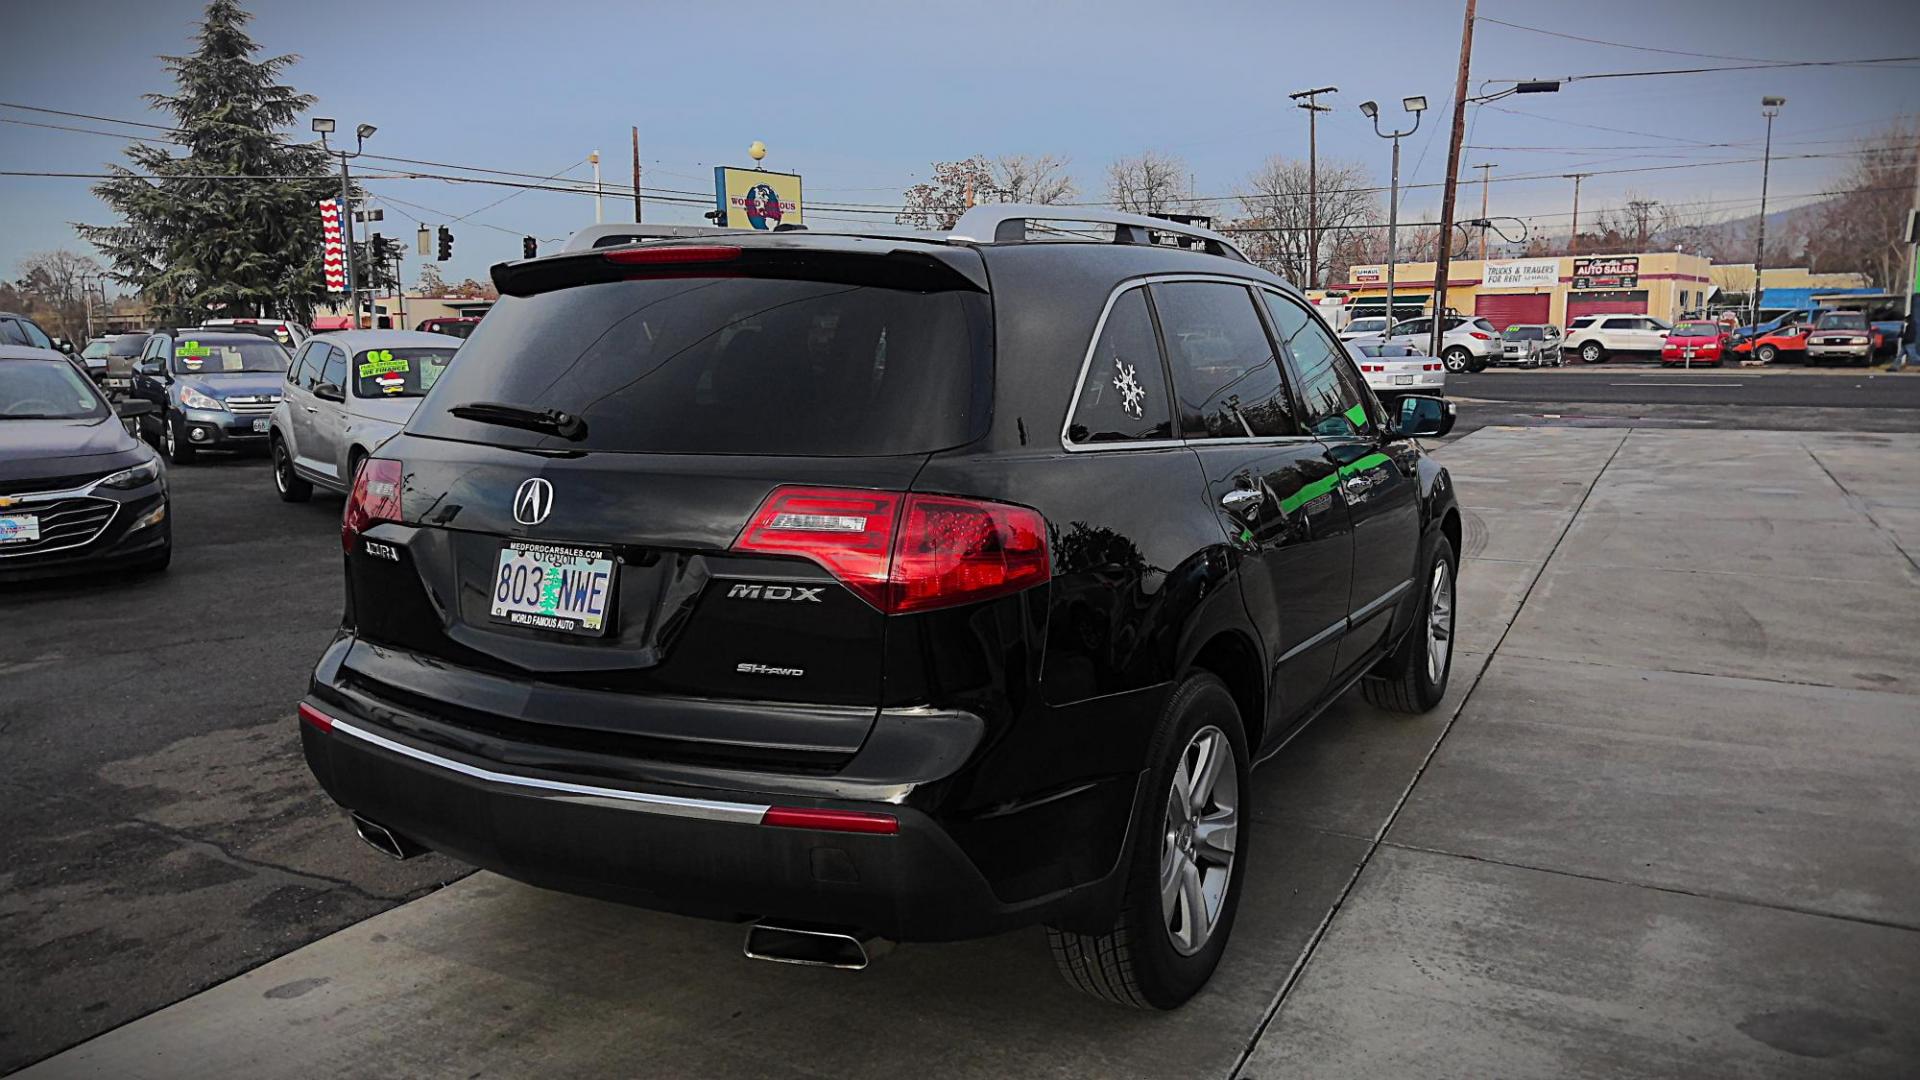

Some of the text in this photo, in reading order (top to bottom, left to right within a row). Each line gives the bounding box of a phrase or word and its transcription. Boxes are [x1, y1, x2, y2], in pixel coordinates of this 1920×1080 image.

[731, 198, 796, 210] WOD FOUS
[1488, 267, 1512, 275] TRUCKS
[1523, 265, 1554, 274] TRAILERS
[1577, 264, 1635, 275] AUTO SALES
[1504, 275, 1521, 283] RENT
[510, 542, 603, 559] MEDFORDCARSALES.COM
[534, 552, 577, 567] Oregon
[497, 563, 608, 615] 803 NWE
[727, 584, 826, 603] MDX
[511, 612, 531, 625] WORLD
[532, 615, 557, 628] FAMOUS
[557, 619, 575, 631] AUTO
[737, 663, 804, 676] SH-AWD
